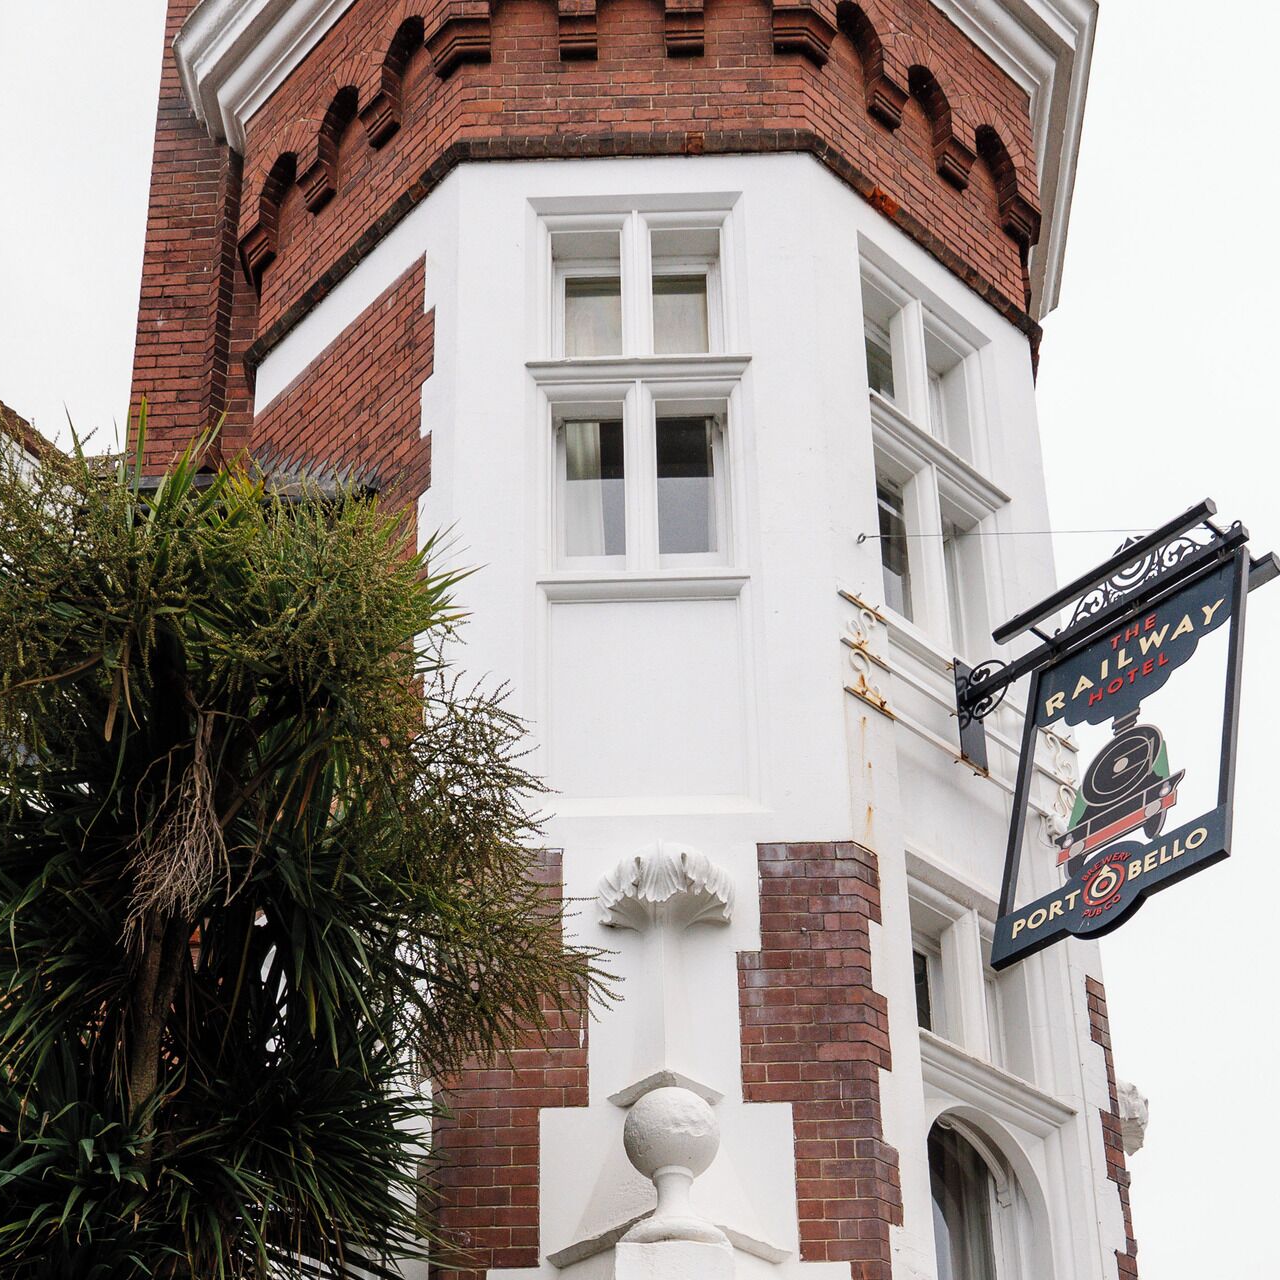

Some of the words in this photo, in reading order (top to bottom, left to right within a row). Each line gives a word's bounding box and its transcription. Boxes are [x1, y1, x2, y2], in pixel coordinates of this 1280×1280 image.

[1111, 613, 1157, 650] THE
[1045, 598, 1225, 717] RAILWAY
[1088, 652, 1169, 707] HOTEL
[1082, 851, 1131, 882] BREWERY
[1082, 907, 1103, 918] PUB
[1104, 894, 1121, 911] CO
